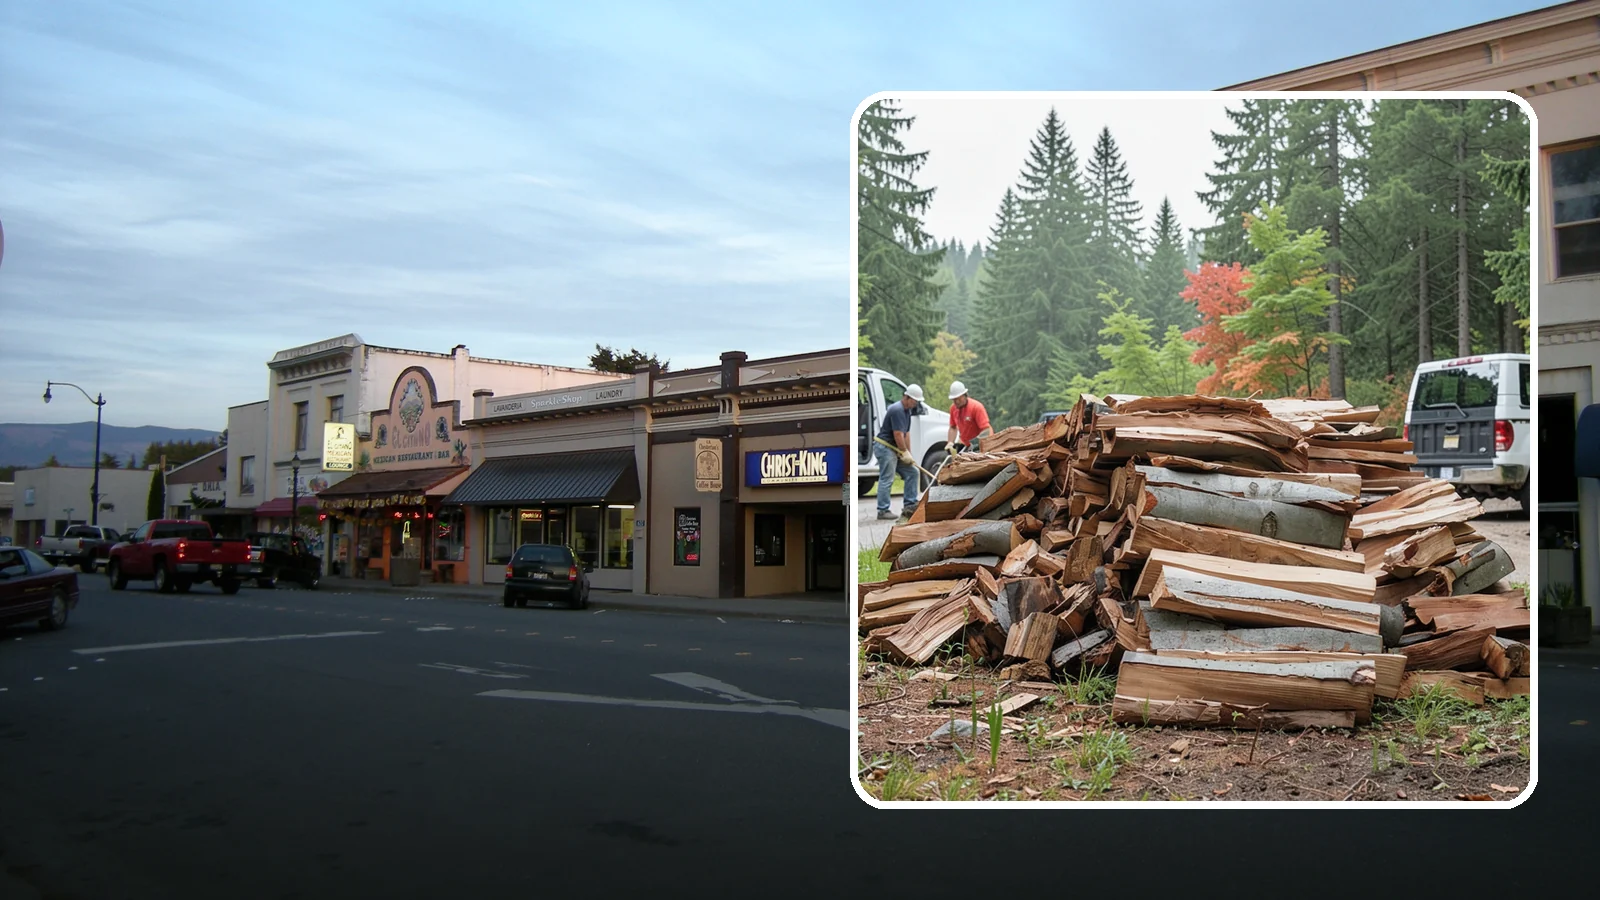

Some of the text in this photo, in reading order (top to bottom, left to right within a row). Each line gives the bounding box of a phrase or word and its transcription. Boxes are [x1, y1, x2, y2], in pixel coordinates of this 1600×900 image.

[595, 389, 624, 400] LAUNDRY
[493, 402, 523, 412] LAVANDERIA
[530, 394, 583, 410] Sparkle Shop
[398, 451, 434, 462] RESTAURANT
[438, 450, 451, 459] BAR
[761, 450, 827, 478] CHRIST KING
[696, 480, 709, 488] Coffee
